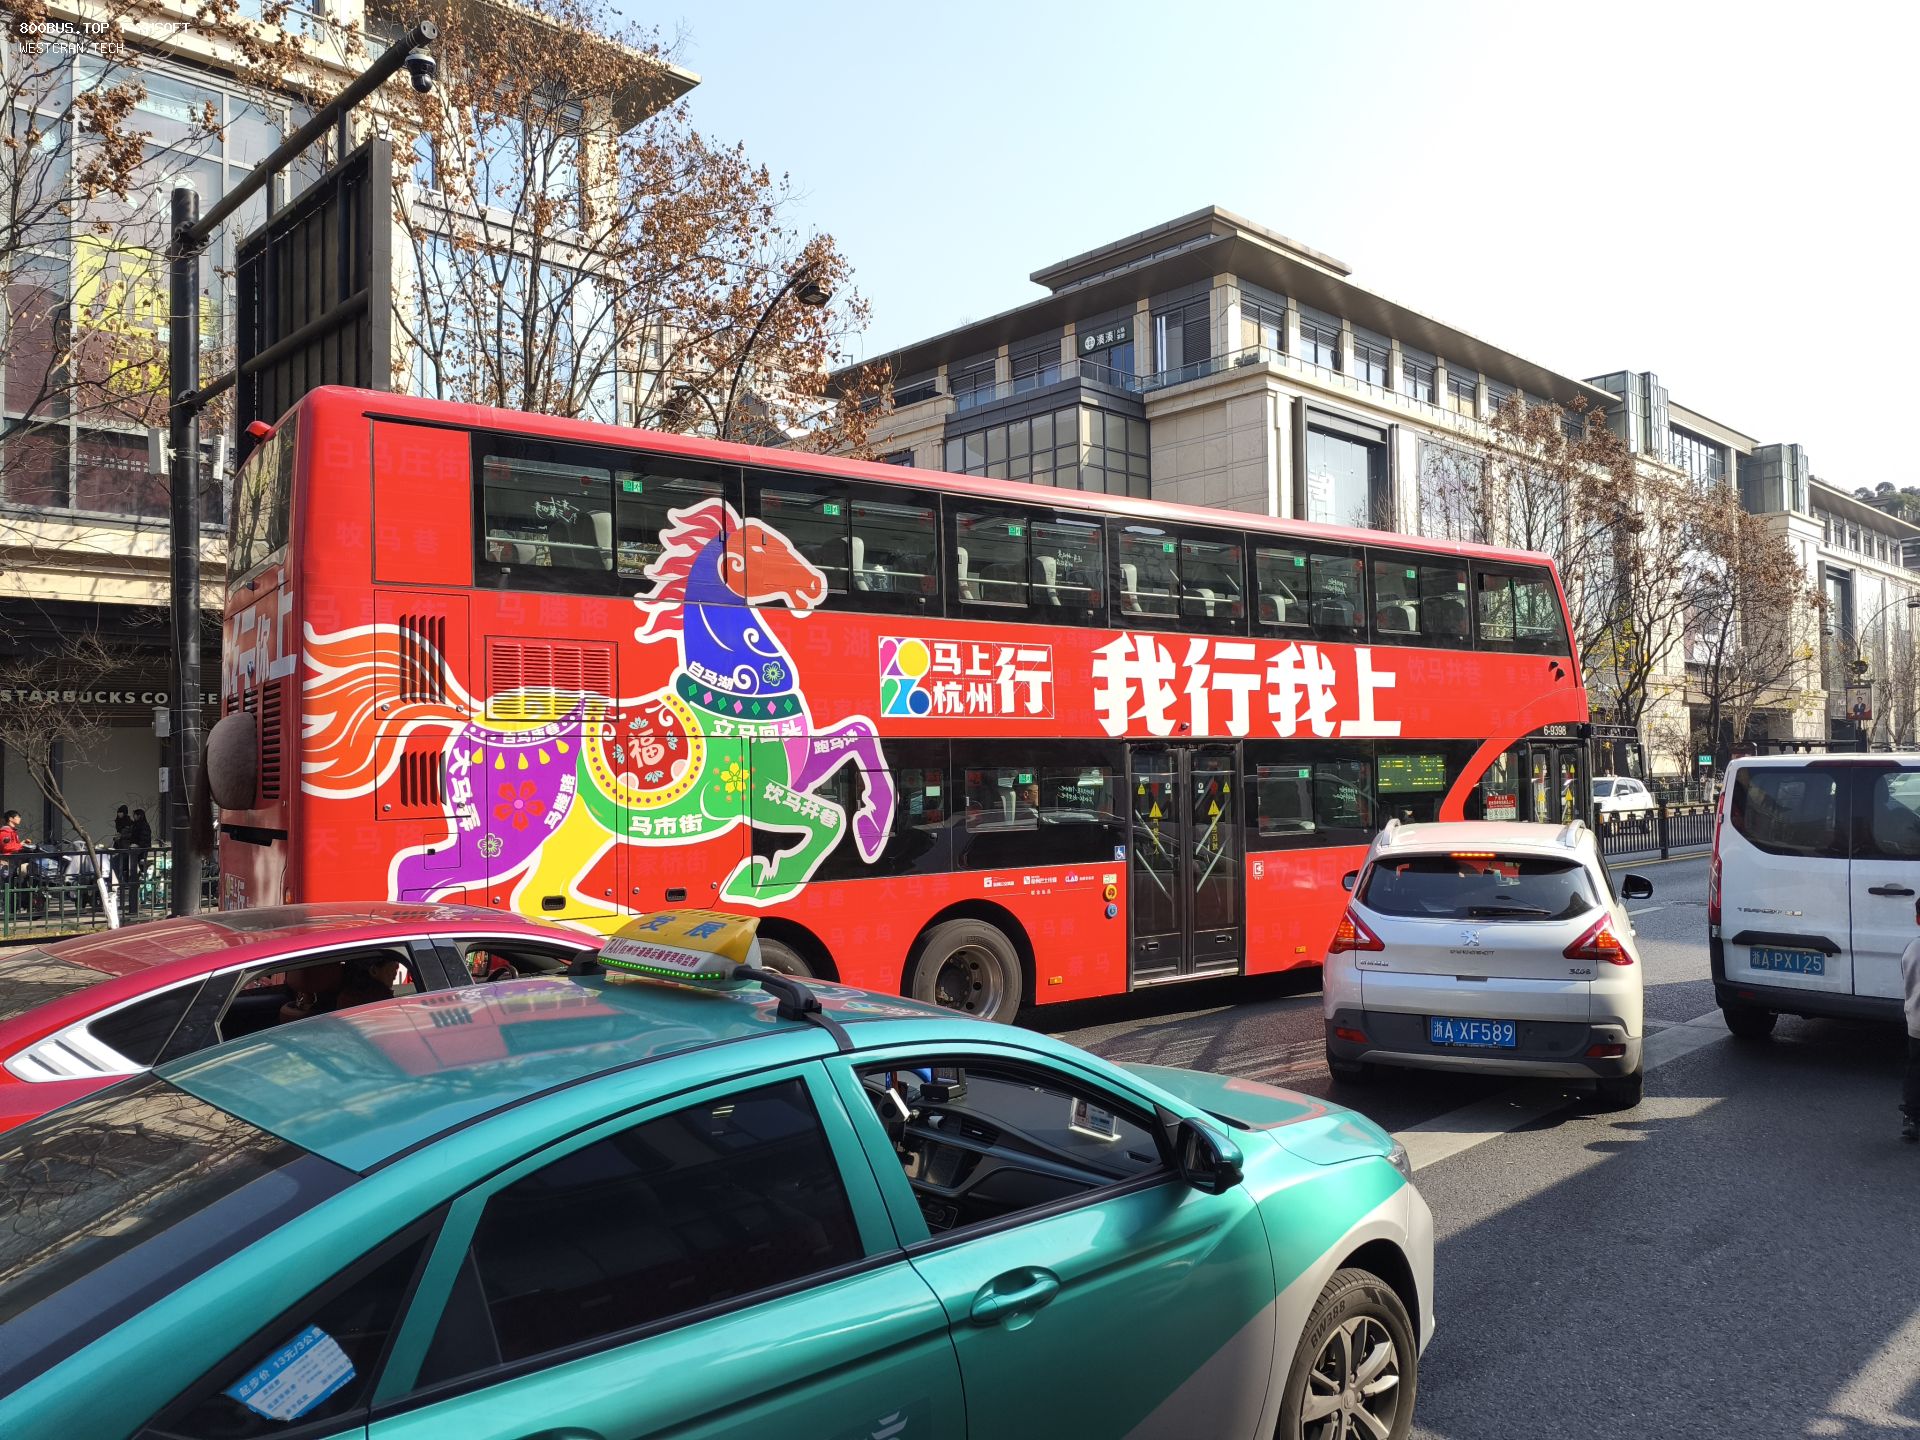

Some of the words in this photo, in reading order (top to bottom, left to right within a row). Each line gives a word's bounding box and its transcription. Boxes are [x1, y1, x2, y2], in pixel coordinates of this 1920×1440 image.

[688, 660, 734, 691] 白马湖
[1091, 632, 1402, 738] 我行我上
[0, 689, 136, 705] STARBUCKS
[140, 692, 218, 705] COEE
[932, 680, 994, 715] 杭州
[710, 719, 803, 744] 立马回头
[1543, 725, 1567, 736] 6-9398
[627, 727, 665, 769] 福
[763, 782, 840, 829] 饮马井巷
[629, 813, 703, 837] 马市街
[640, 915, 728, 939] 发展
